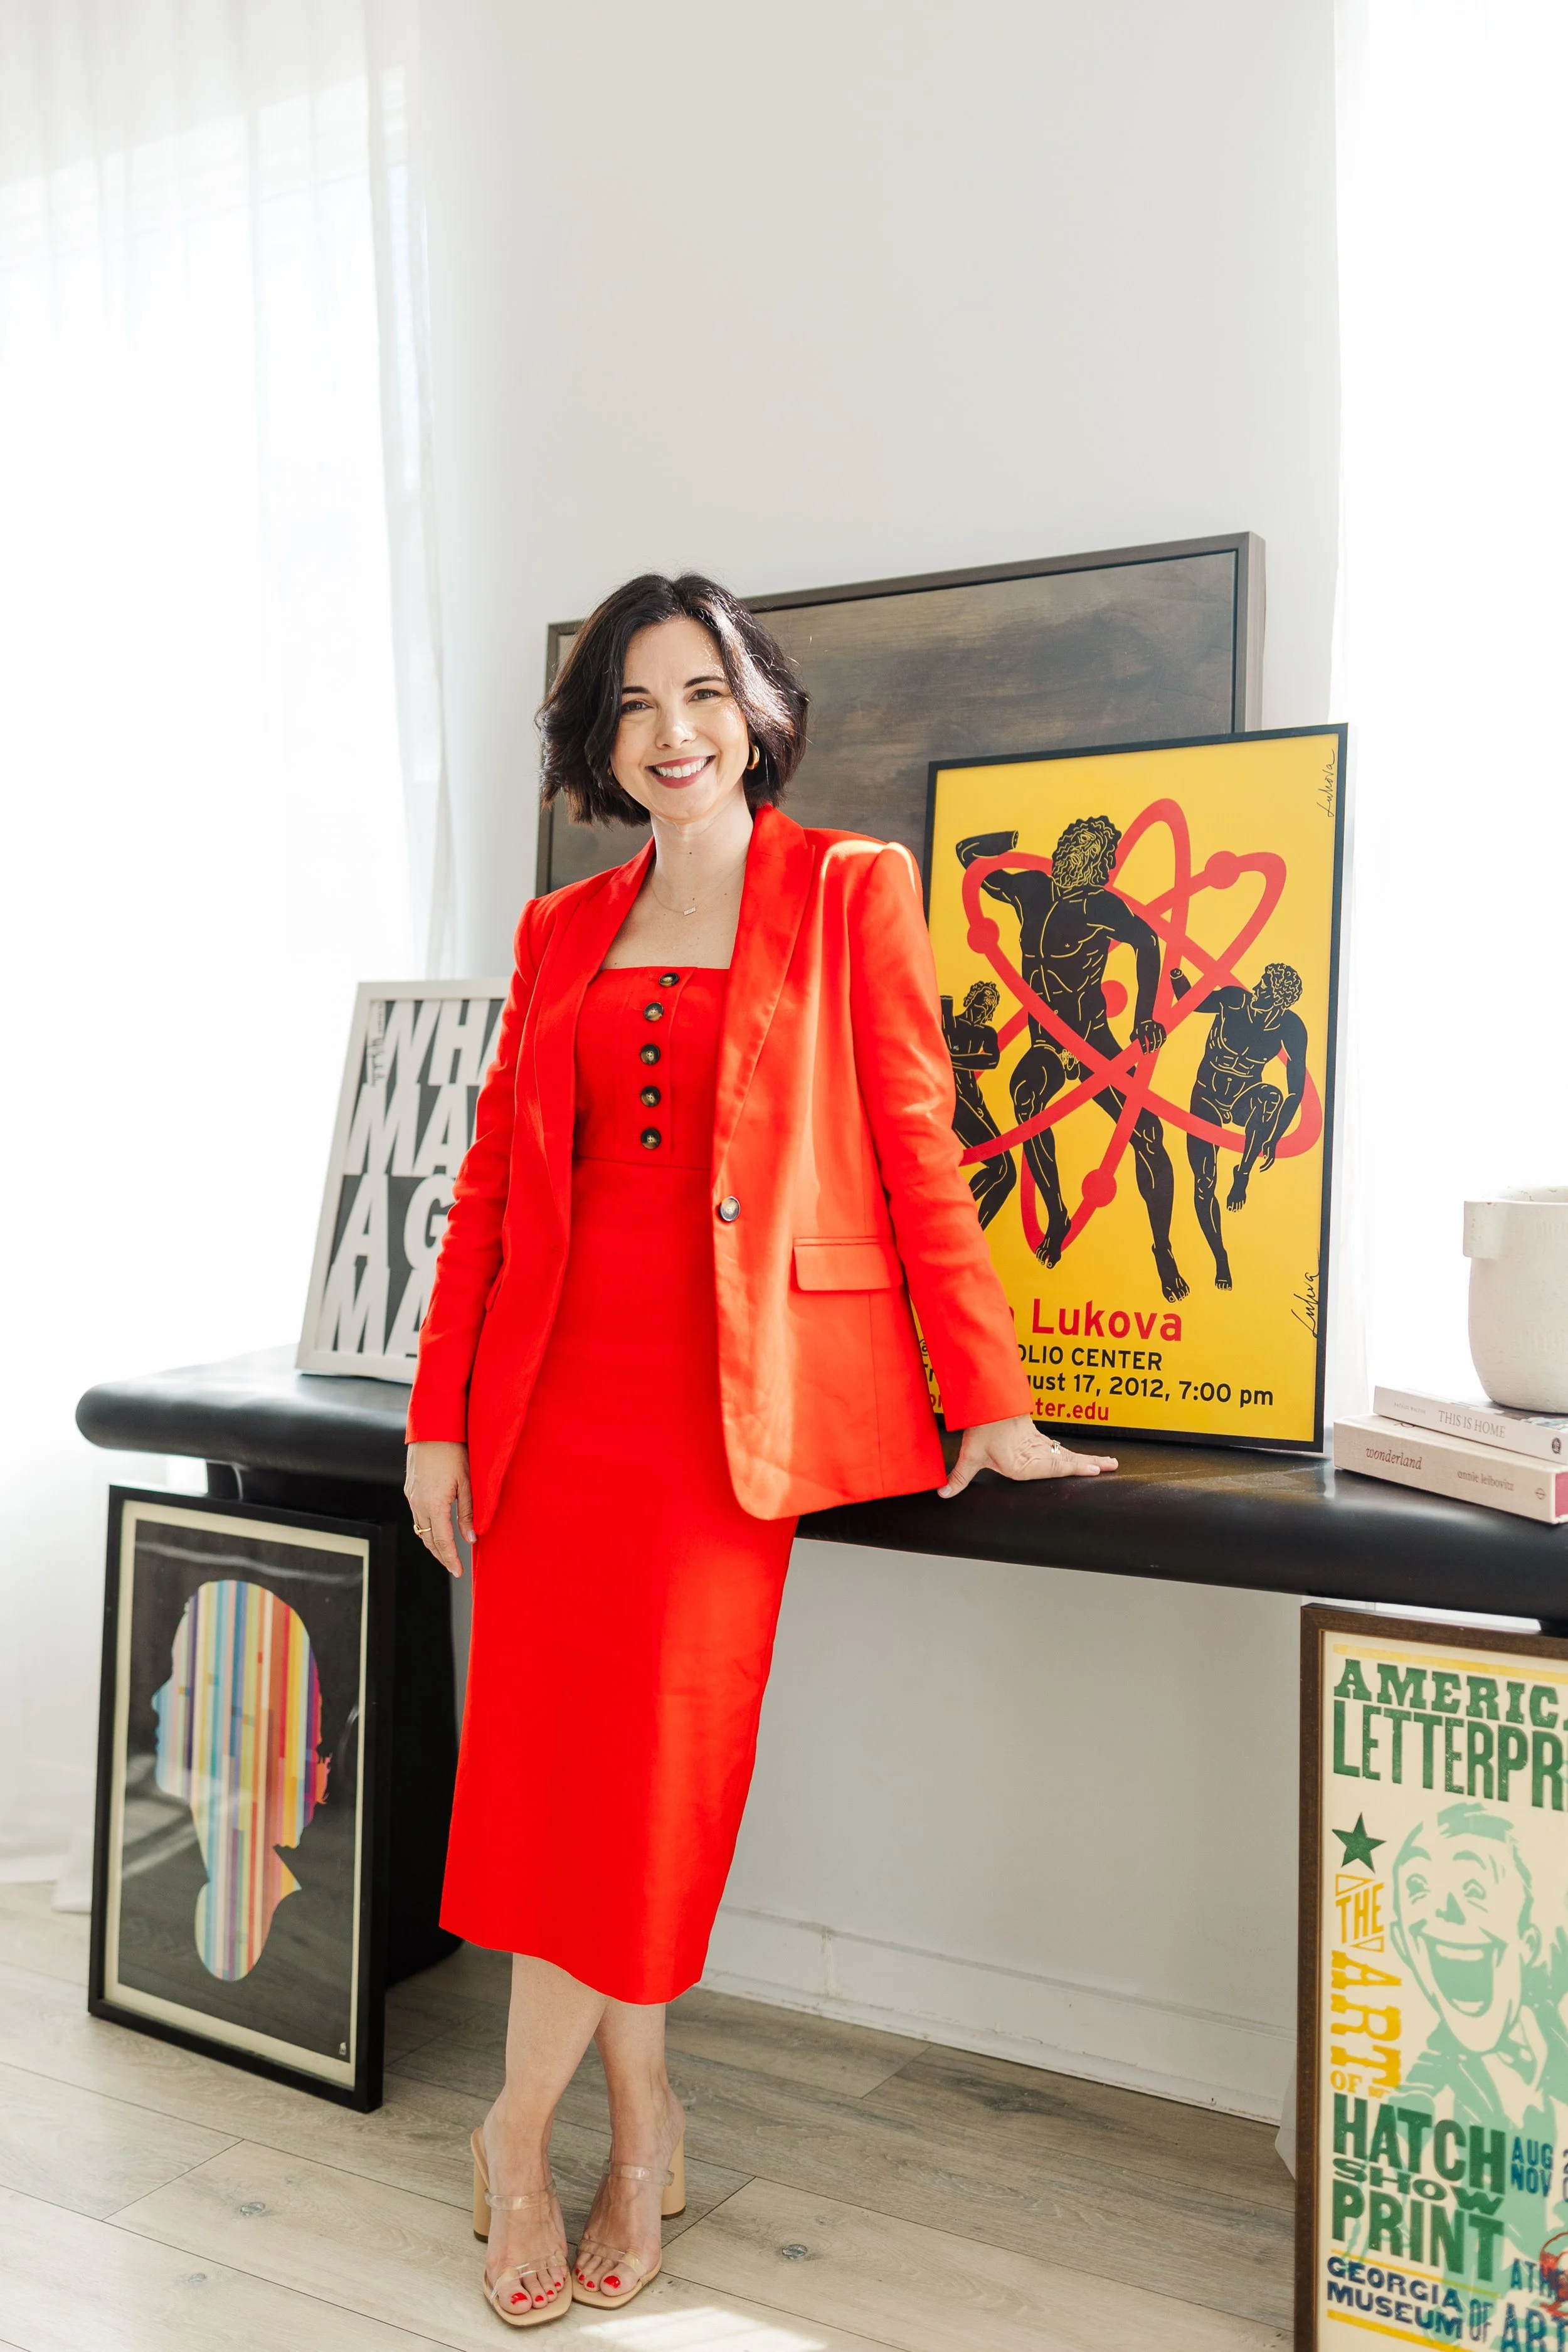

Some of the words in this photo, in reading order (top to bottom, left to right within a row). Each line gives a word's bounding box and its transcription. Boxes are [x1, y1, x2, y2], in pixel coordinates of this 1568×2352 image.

[1032, 1298, 1182, 1342] Lukova
[1071, 1347, 1162, 1371] CENTER
[1030, 1397, 1109, 1421] ter.edu
[1074, 1374, 1101, 1397] 17,
[1109, 1376, 1170, 1402] 2012,
[1179, 1381, 1231, 1402] 7:00
[1240, 1389, 1273, 1408] pm
[1438, 1410, 1461, 1427] THIS
[1463, 1416, 1472, 1429] IS
[1474, 1420, 1505, 1438] HOME
[1366, 1448, 1422, 1470] wonderland
[1458, 1470, 1478, 1483] annie
[1481, 1473, 1514, 1491] leibowitz
[1333, 1659, 1568, 1730] AMERIC
[1333, 1700, 1568, 1813] LETTERPR
[1336, 1882, 1384, 1944] THE
[1331, 1950, 1402, 2089] ART
[1330, 2070, 1362, 2094] OF
[1333, 2092, 1505, 2195] HATCH
[1512, 2136, 1553, 2170] AUG
[1333, 2158, 1504, 2216] SHOW
[1510, 2163, 1552, 2197] NOV
[1332, 2179, 1504, 2282] PRINT
[1327, 2257, 1463, 2312] GEORGIA
[1327, 2280, 1463, 2339] MUSEUM
